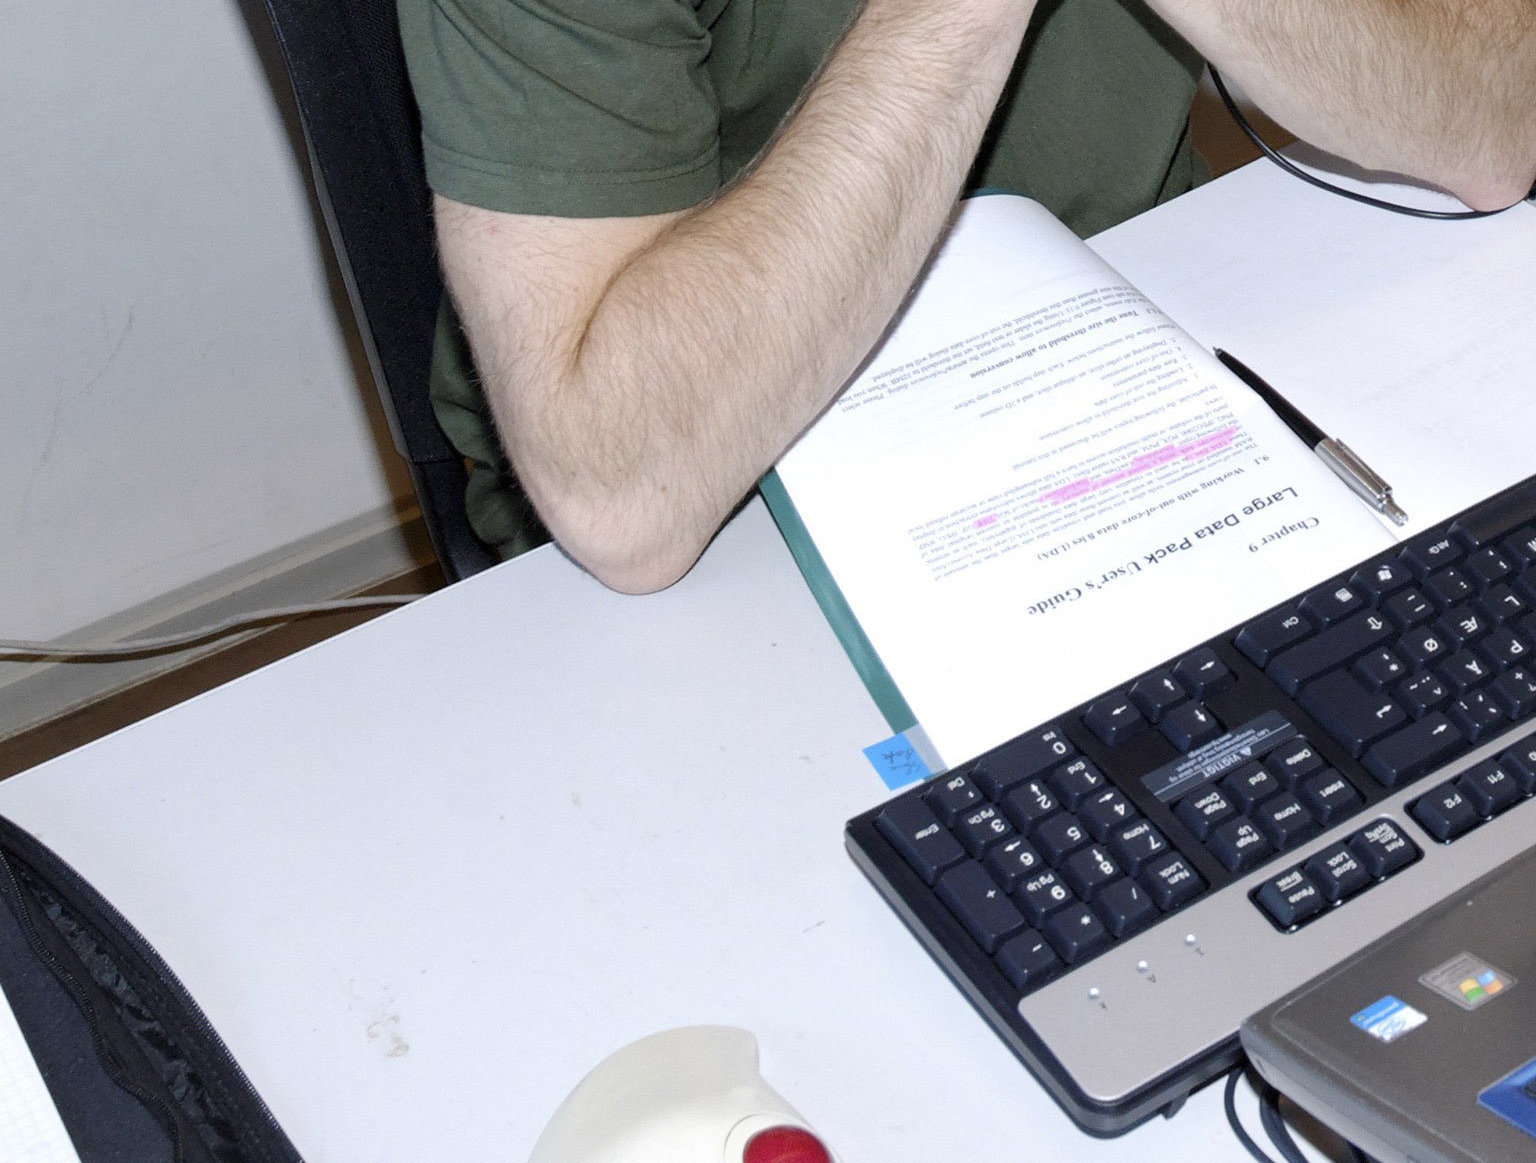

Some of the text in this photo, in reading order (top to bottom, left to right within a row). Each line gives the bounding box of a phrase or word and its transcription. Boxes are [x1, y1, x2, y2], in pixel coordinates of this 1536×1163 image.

[1254, 454, 1268, 465] 9.1
[1199, 467, 1244, 490] Working
[1176, 488, 1199, 501] with
[1121, 498, 1176, 525] out-of-core
[1096, 522, 1119, 535] data
[1248, 517, 1319, 553] Chapter 9
[1026, 486, 1298, 615] Large Data Pack User's Guide
[1037, 542, 1070, 561] (LDA)
[1503, 595, 1521, 607] L
[1459, 616, 1479, 634] Æ
[1423, 637, 1439, 653] Ø
[1510, 639, 1524, 655] P
[1465, 659, 1483, 675] Å
[1285, 748, 1312, 766] Delete
[1201, 753, 1242, 779] VIGTIGT
[947, 776, 965, 791] Del
[1248, 771, 1268, 786] End
[1319, 779, 1346, 798] Insert
[1194, 792, 1220, 810] Down
[1204, 799, 1227, 815] Page
[1113, 803, 1126, 816] 4
[1273, 802, 1302, 821] Home
[914, 823, 940, 840] Enter
[1066, 826, 1082, 842] 5
[1236, 831, 1259, 849] Page
[1019, 851, 1035, 867] 6
